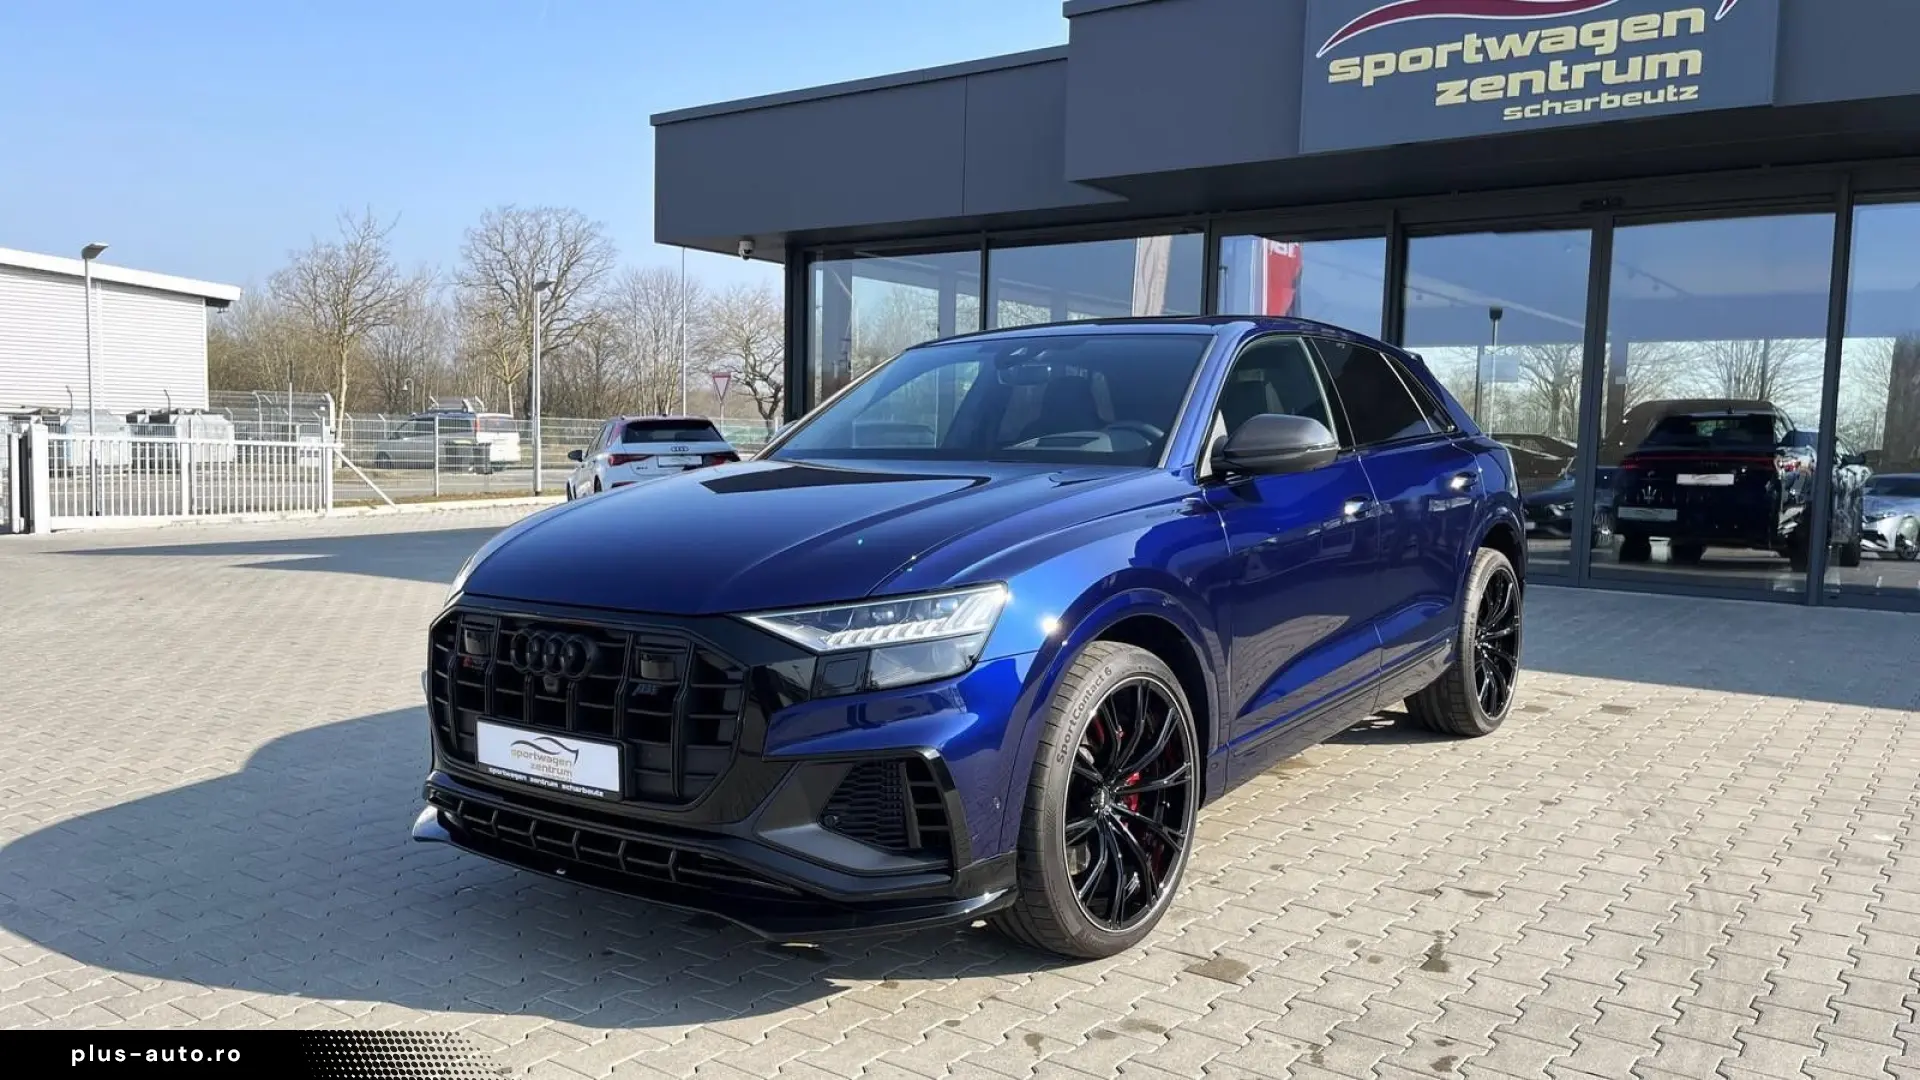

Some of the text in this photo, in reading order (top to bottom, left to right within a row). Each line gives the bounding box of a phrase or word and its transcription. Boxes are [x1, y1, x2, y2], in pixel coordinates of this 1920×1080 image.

[1328, 7, 1704, 87] sportwagen
[1435, 48, 1703, 106] zentrum
[1502, 84, 1698, 120] scharbeutz
[1057, 666, 1112, 764] SportContact 6
[511, 749, 572, 767] sportwagen
[531, 762, 573, 777] zentrum
